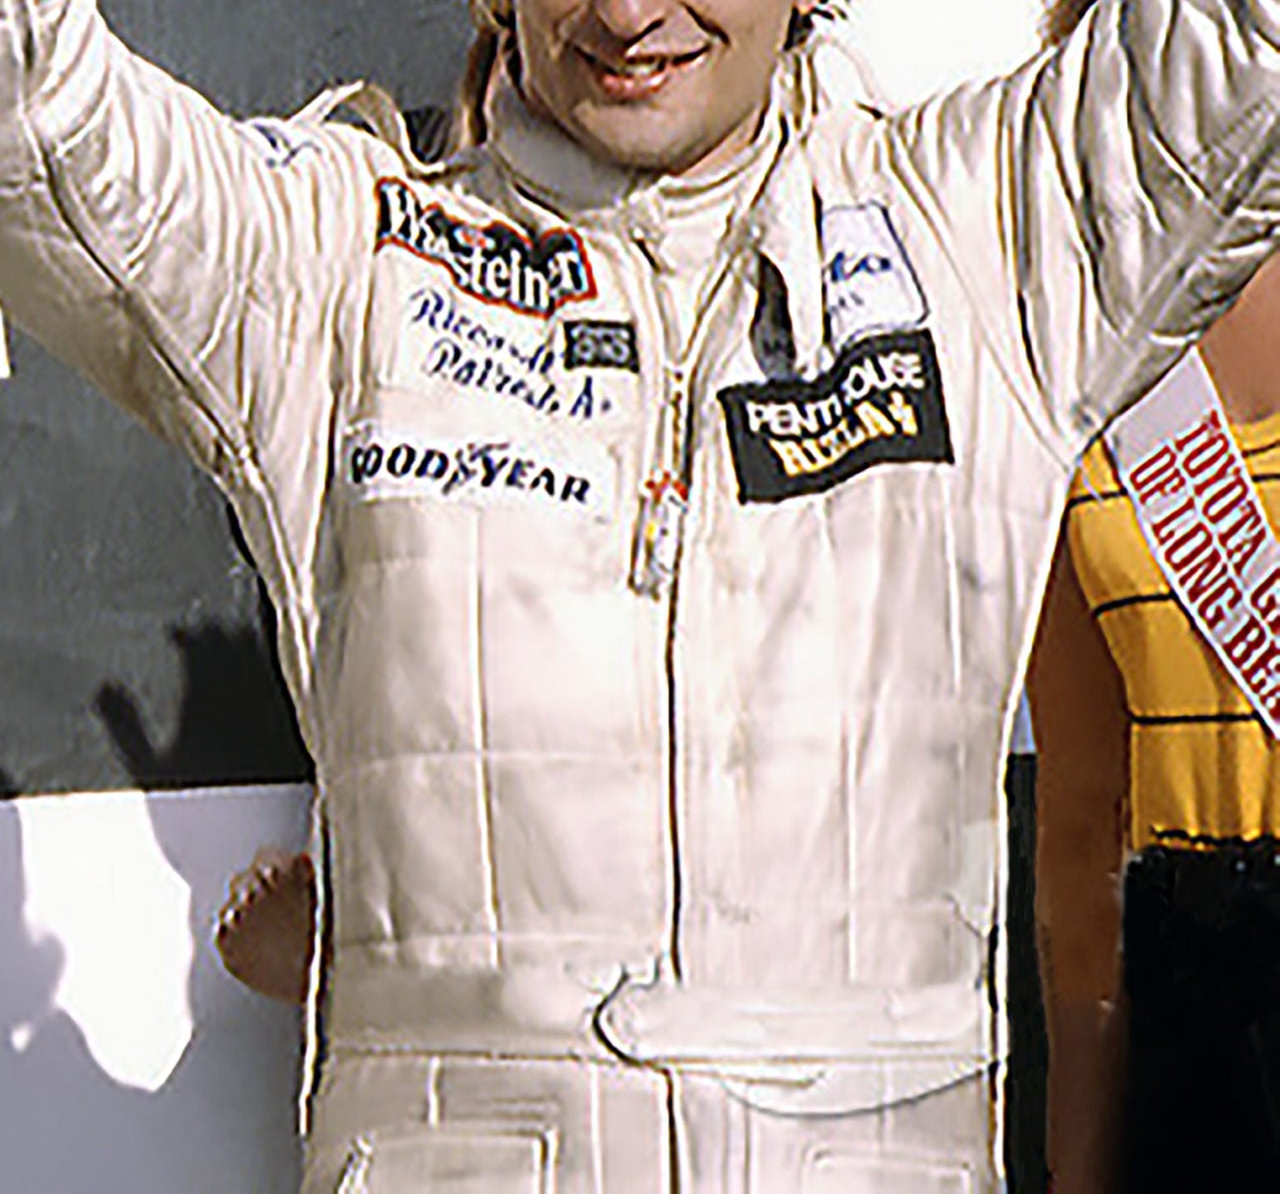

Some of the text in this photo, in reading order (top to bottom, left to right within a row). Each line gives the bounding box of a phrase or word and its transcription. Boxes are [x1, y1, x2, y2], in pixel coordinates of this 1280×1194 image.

[746, 351, 925, 438] PENTOUSE
[1129, 445, 1187, 506] OF
[1175, 410, 1268, 578] TOYOTA
[1152, 501, 1243, 630] LONG
